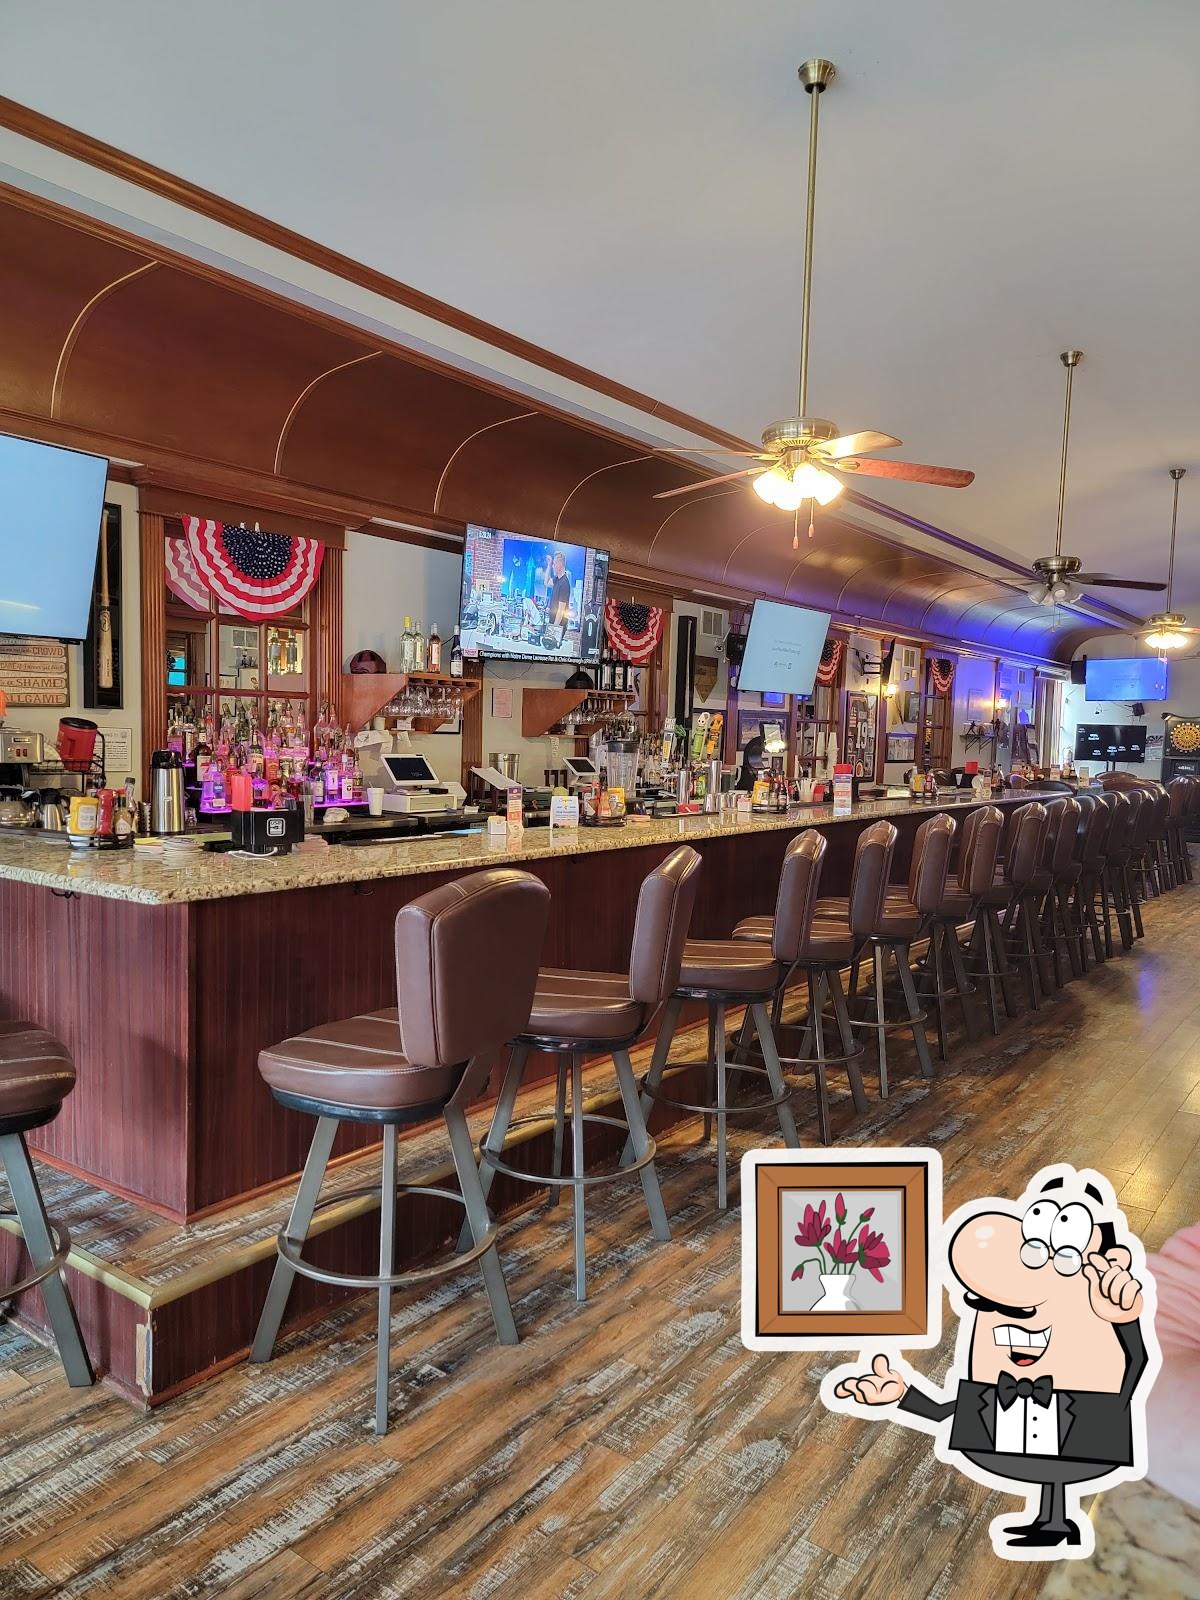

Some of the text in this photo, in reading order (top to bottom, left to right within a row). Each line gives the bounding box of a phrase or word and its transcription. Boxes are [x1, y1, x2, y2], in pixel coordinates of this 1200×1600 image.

[32, 646, 63, 656] CROWD
[16, 678, 63, 688] SHAME!
[5, 694, 64, 704] ALLGAME
